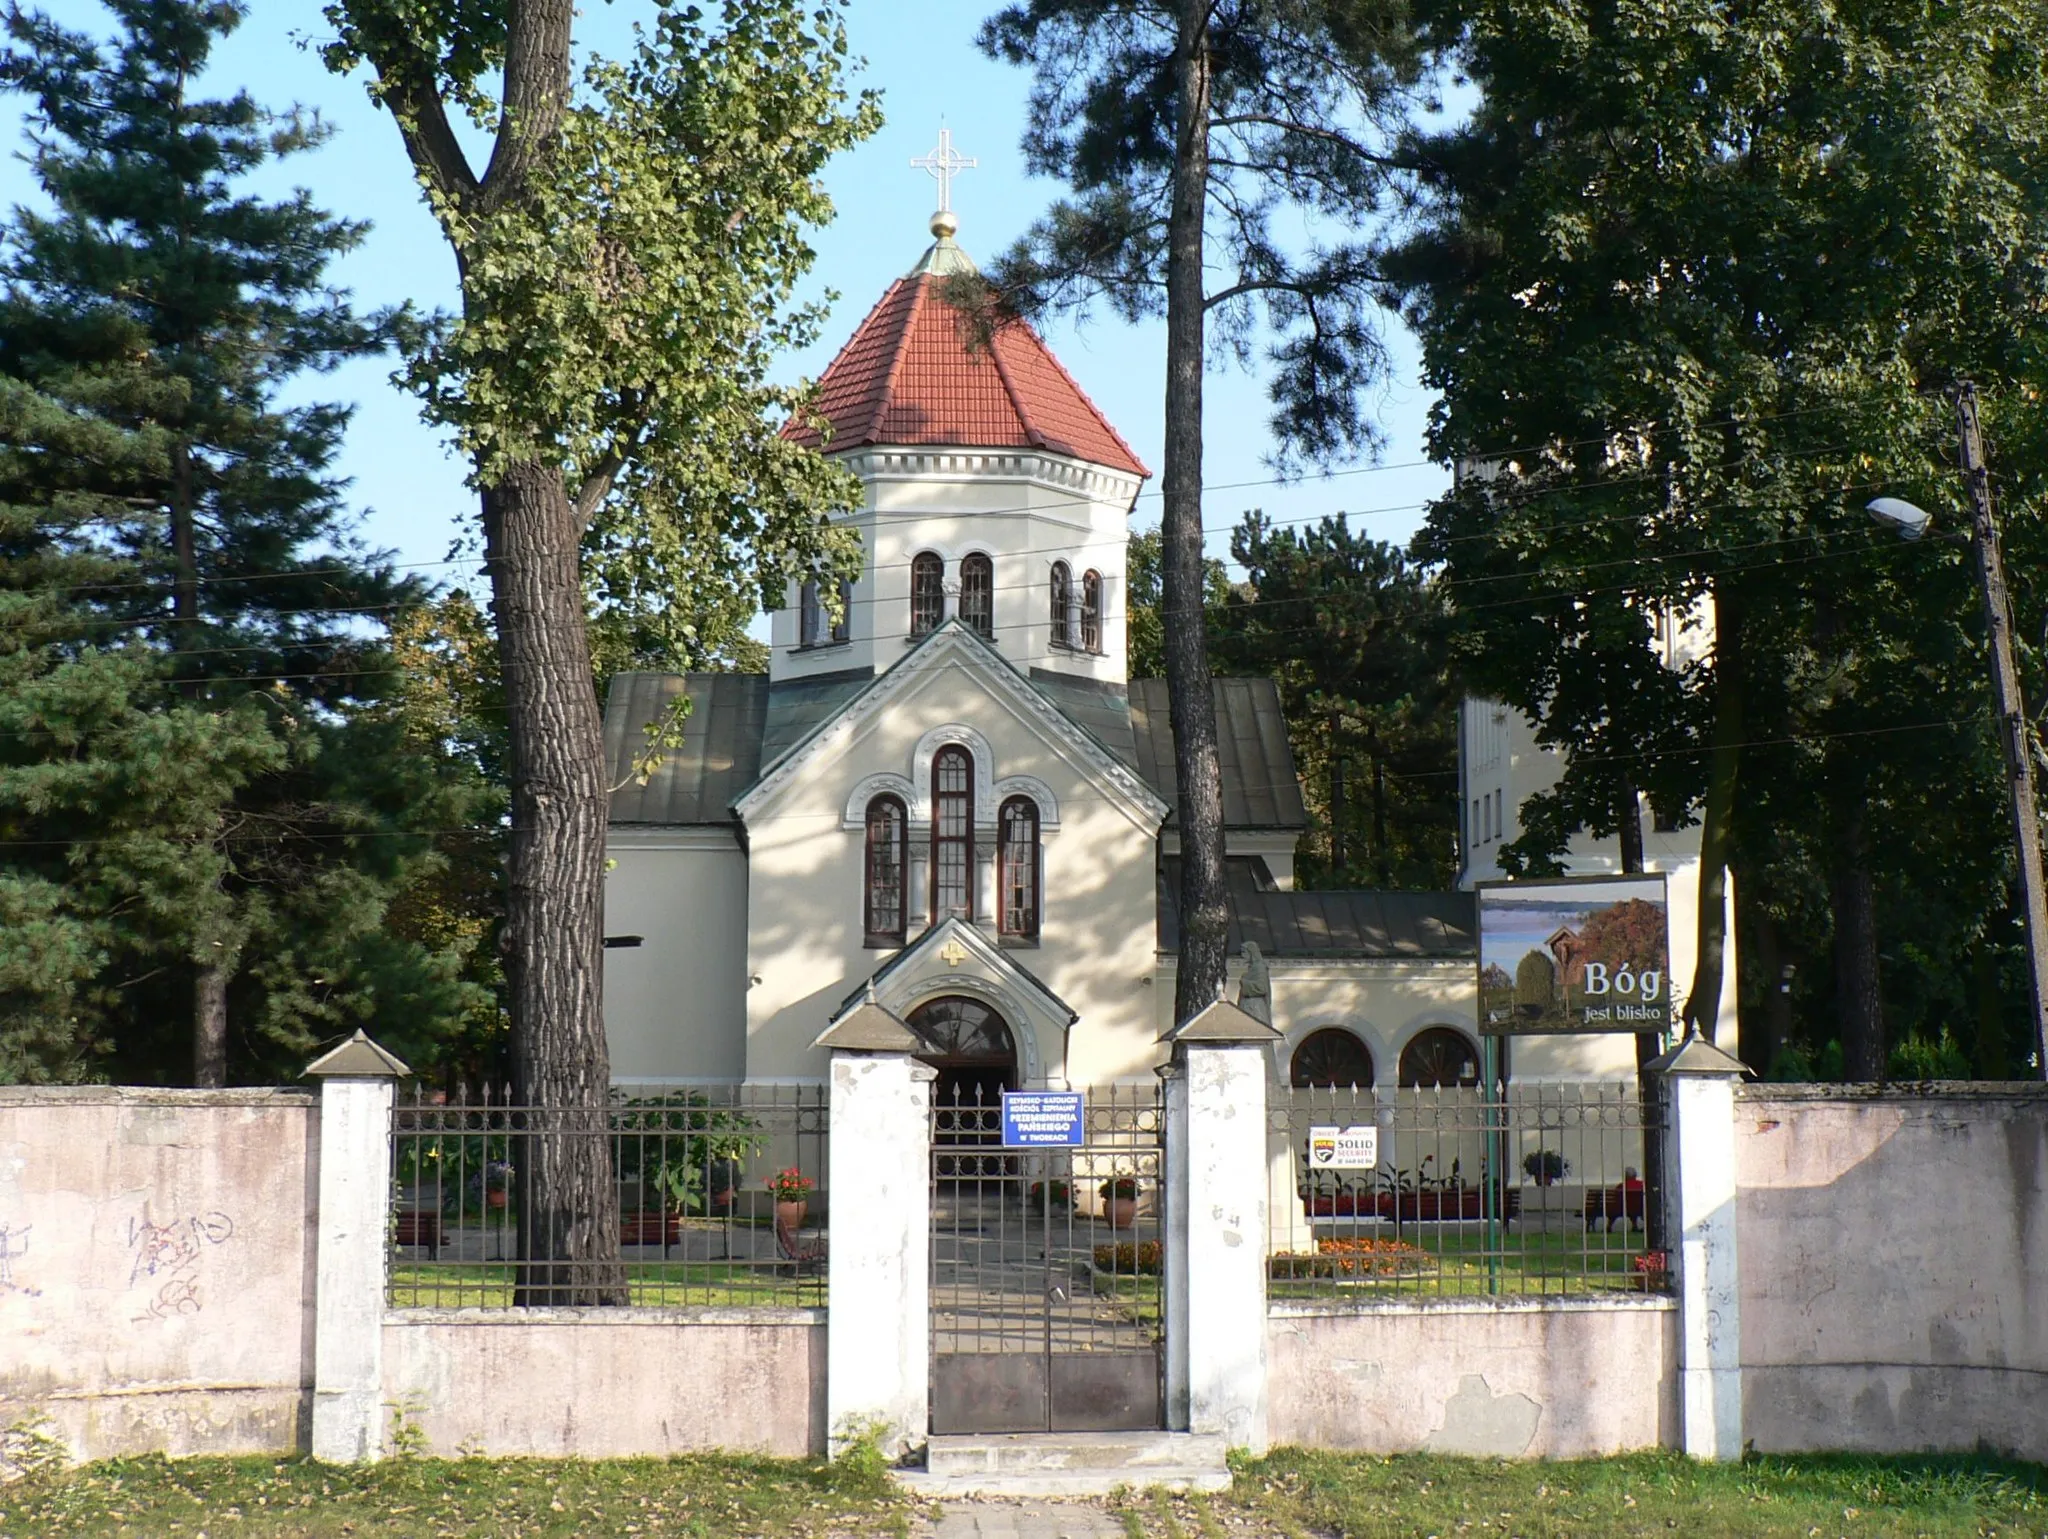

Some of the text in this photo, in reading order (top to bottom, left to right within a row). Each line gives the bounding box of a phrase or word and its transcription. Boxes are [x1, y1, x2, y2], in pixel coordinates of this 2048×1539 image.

[1583, 962, 1661, 1002] Bóg
[1583, 1004, 1661, 1024] jest blisko
[1009, 1103, 1076, 1112] KOŚCIÓŁ SZPITALNY
[1009, 1113, 1077, 1122] PRZEMIENIENIA
[1017, 1122, 1071, 1132] PAŃSKIEGO
[1337, 1139, 1374, 1149] SOLID
